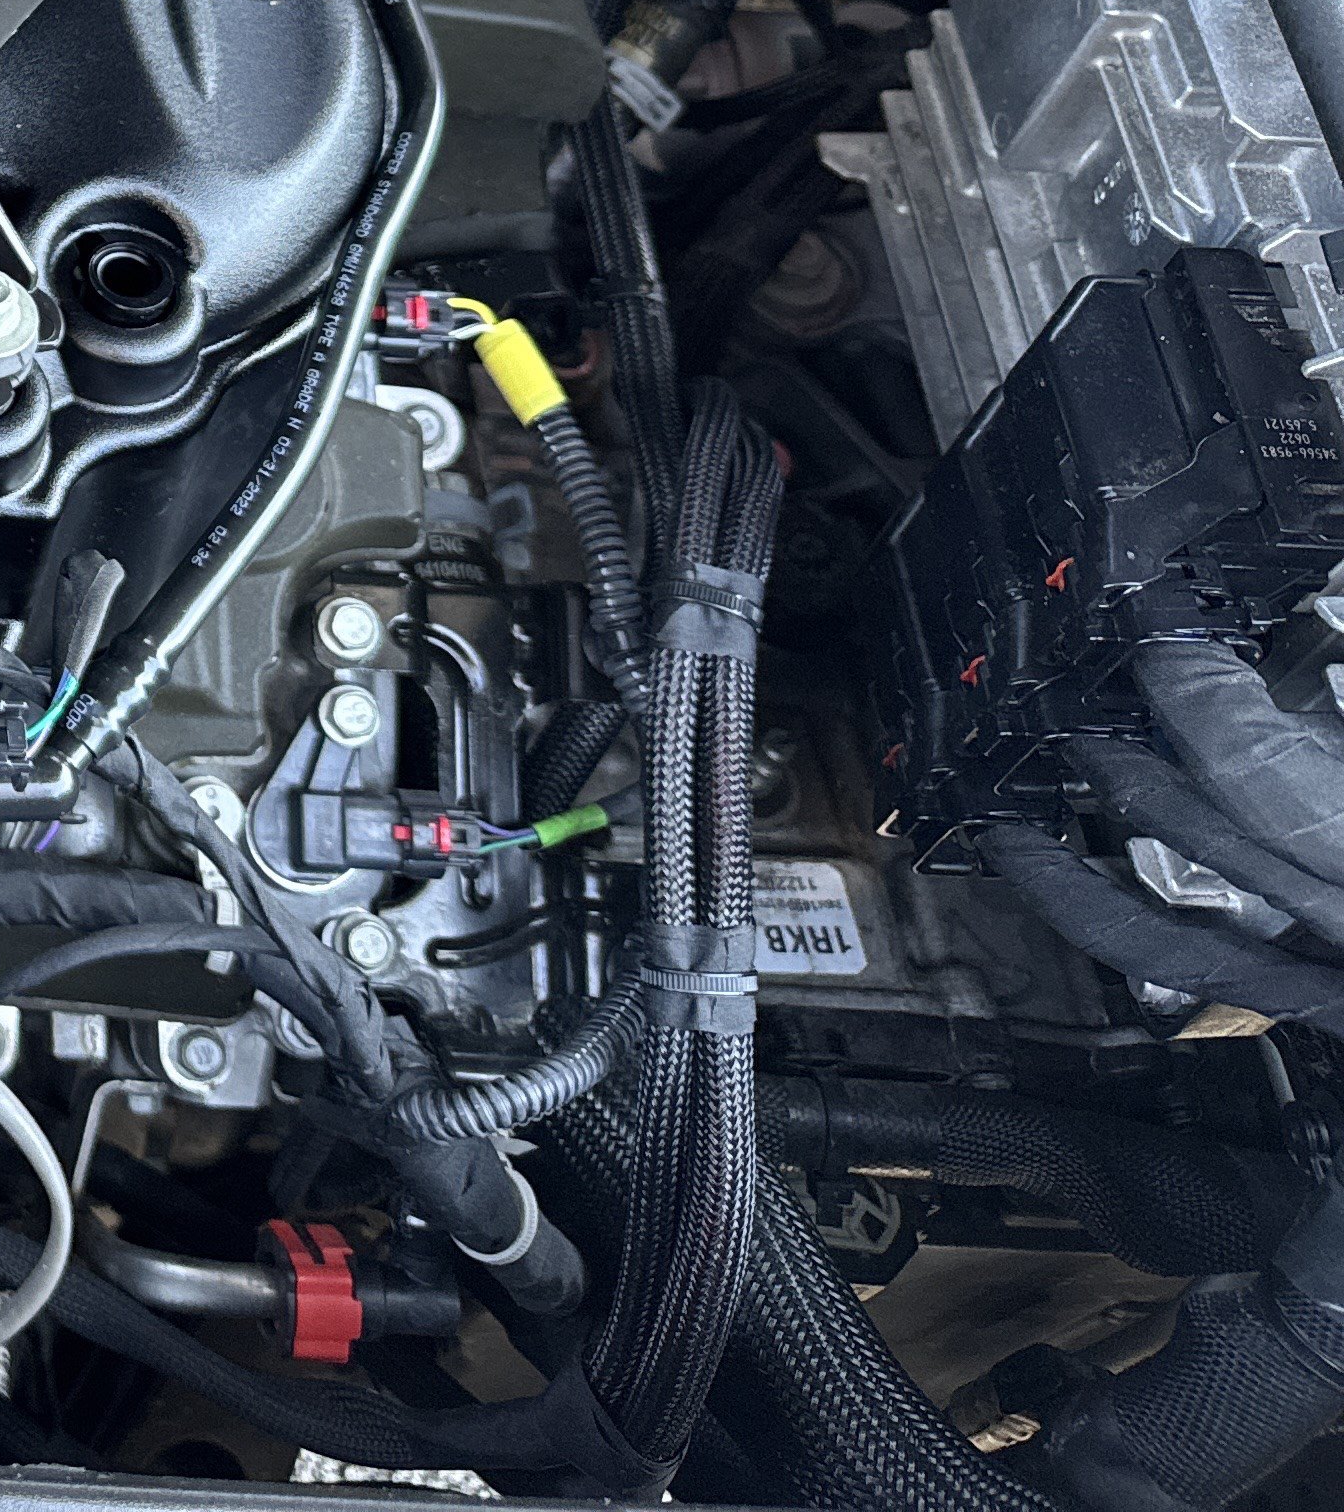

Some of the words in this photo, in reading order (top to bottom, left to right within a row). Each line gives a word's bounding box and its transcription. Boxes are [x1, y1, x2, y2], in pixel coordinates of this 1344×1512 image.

[384, 131, 412, 175] COOPER
[355, 179, 392, 238] STANDARD
[330, 243, 363, 307] GMW14638
[317, 314, 341, 347] TYPE
[312, 351, 326, 363] A
[293, 368, 322, 413] GRADE
[286, 416, 305, 430] N
[1279, 432, 1311, 444] 0622
[230, 435, 292, 517] 03/31/2022
[765, 924, 853, 955] 1RKB
